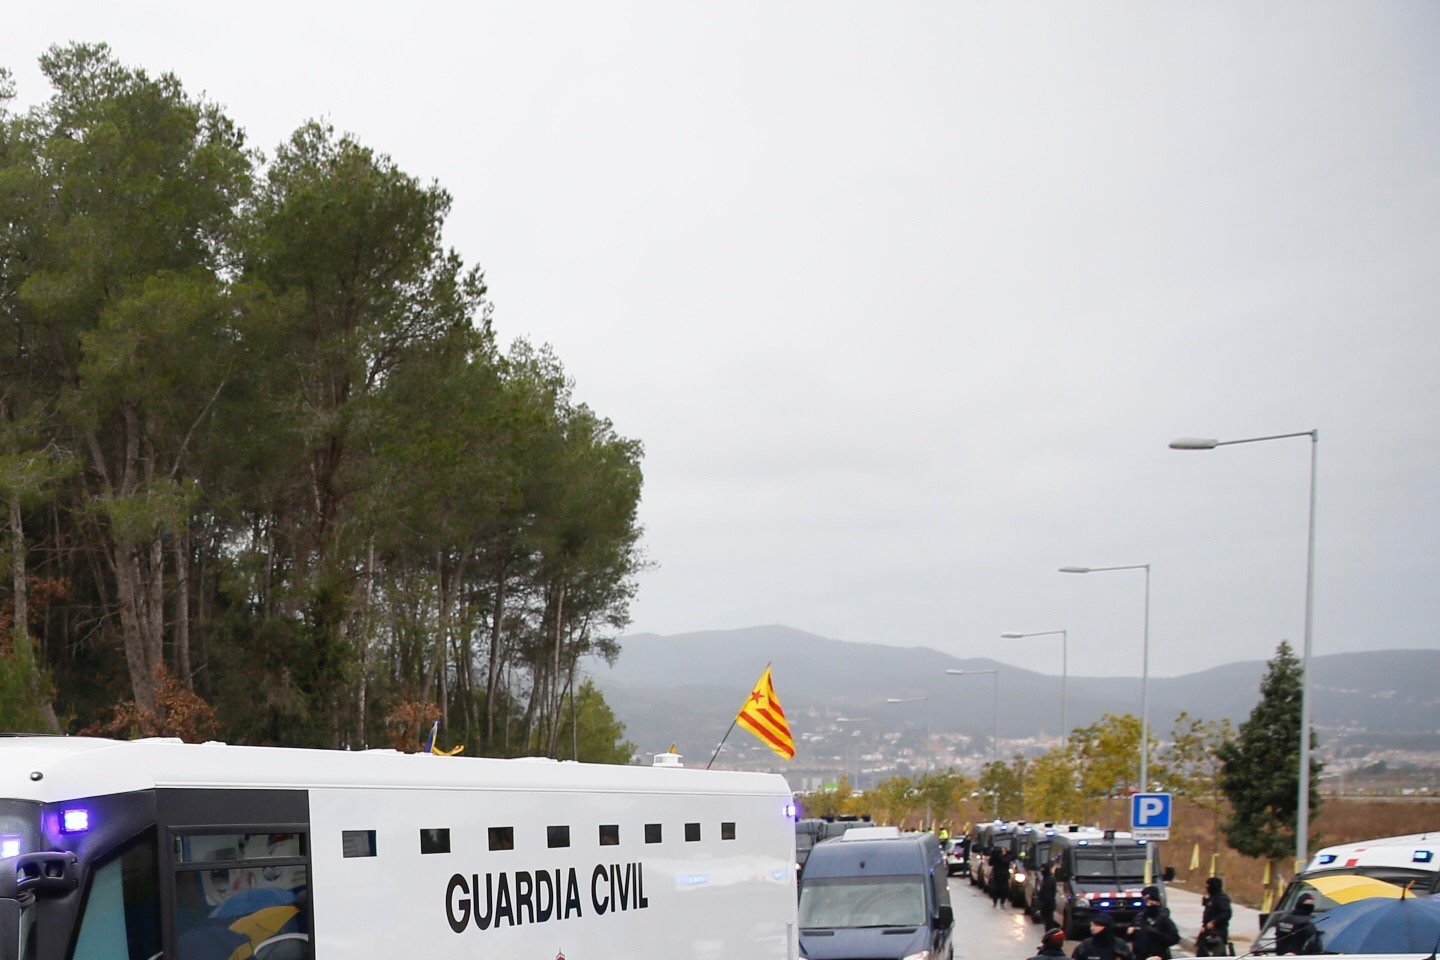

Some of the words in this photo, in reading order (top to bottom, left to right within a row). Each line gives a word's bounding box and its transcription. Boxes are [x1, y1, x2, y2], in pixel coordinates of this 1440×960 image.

[1139, 798, 1163, 824] P
[445, 866, 582, 934] GUARDIA
[591, 862, 649, 915] CIVIL
